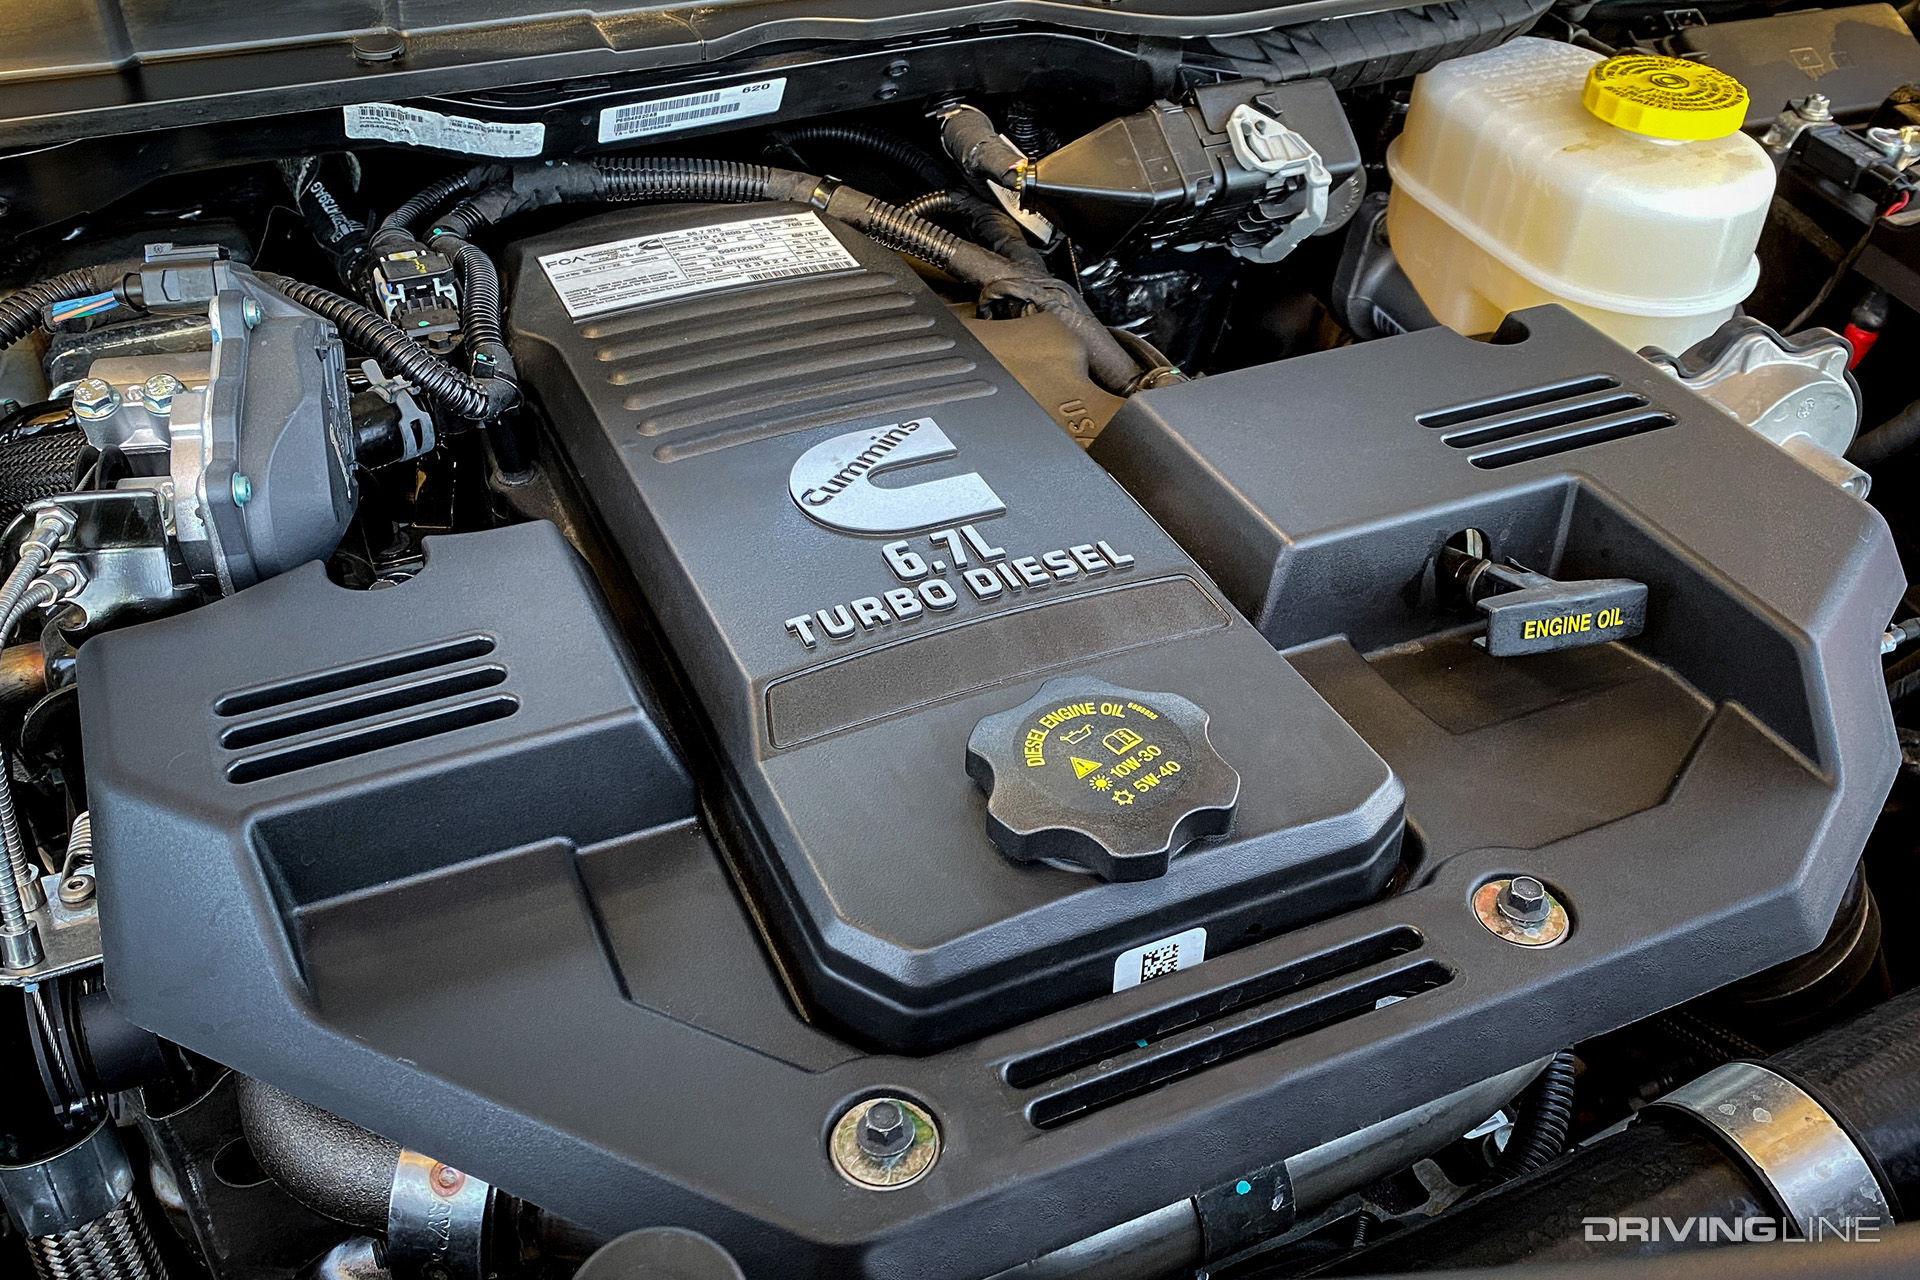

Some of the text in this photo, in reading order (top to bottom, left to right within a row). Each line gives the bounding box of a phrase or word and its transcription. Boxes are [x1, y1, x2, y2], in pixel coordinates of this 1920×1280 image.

[742, 83, 770, 94] 620
[545, 256, 586, 268] FCA
[712, 256, 764, 267] ELECTRONIC
[801, 420, 920, 506] Cummins
[882, 524, 1006, 582] 6.7L
[785, 540, 1134, 649] TURBO DIESEL
[1523, 607, 1624, 640] ENGINE OIL
[1024, 702, 1125, 767] DIESEL ENGINE OIL
[1109, 745, 1162, 778] 10W-30
[1133, 761, 1181, 792] 5W-40
